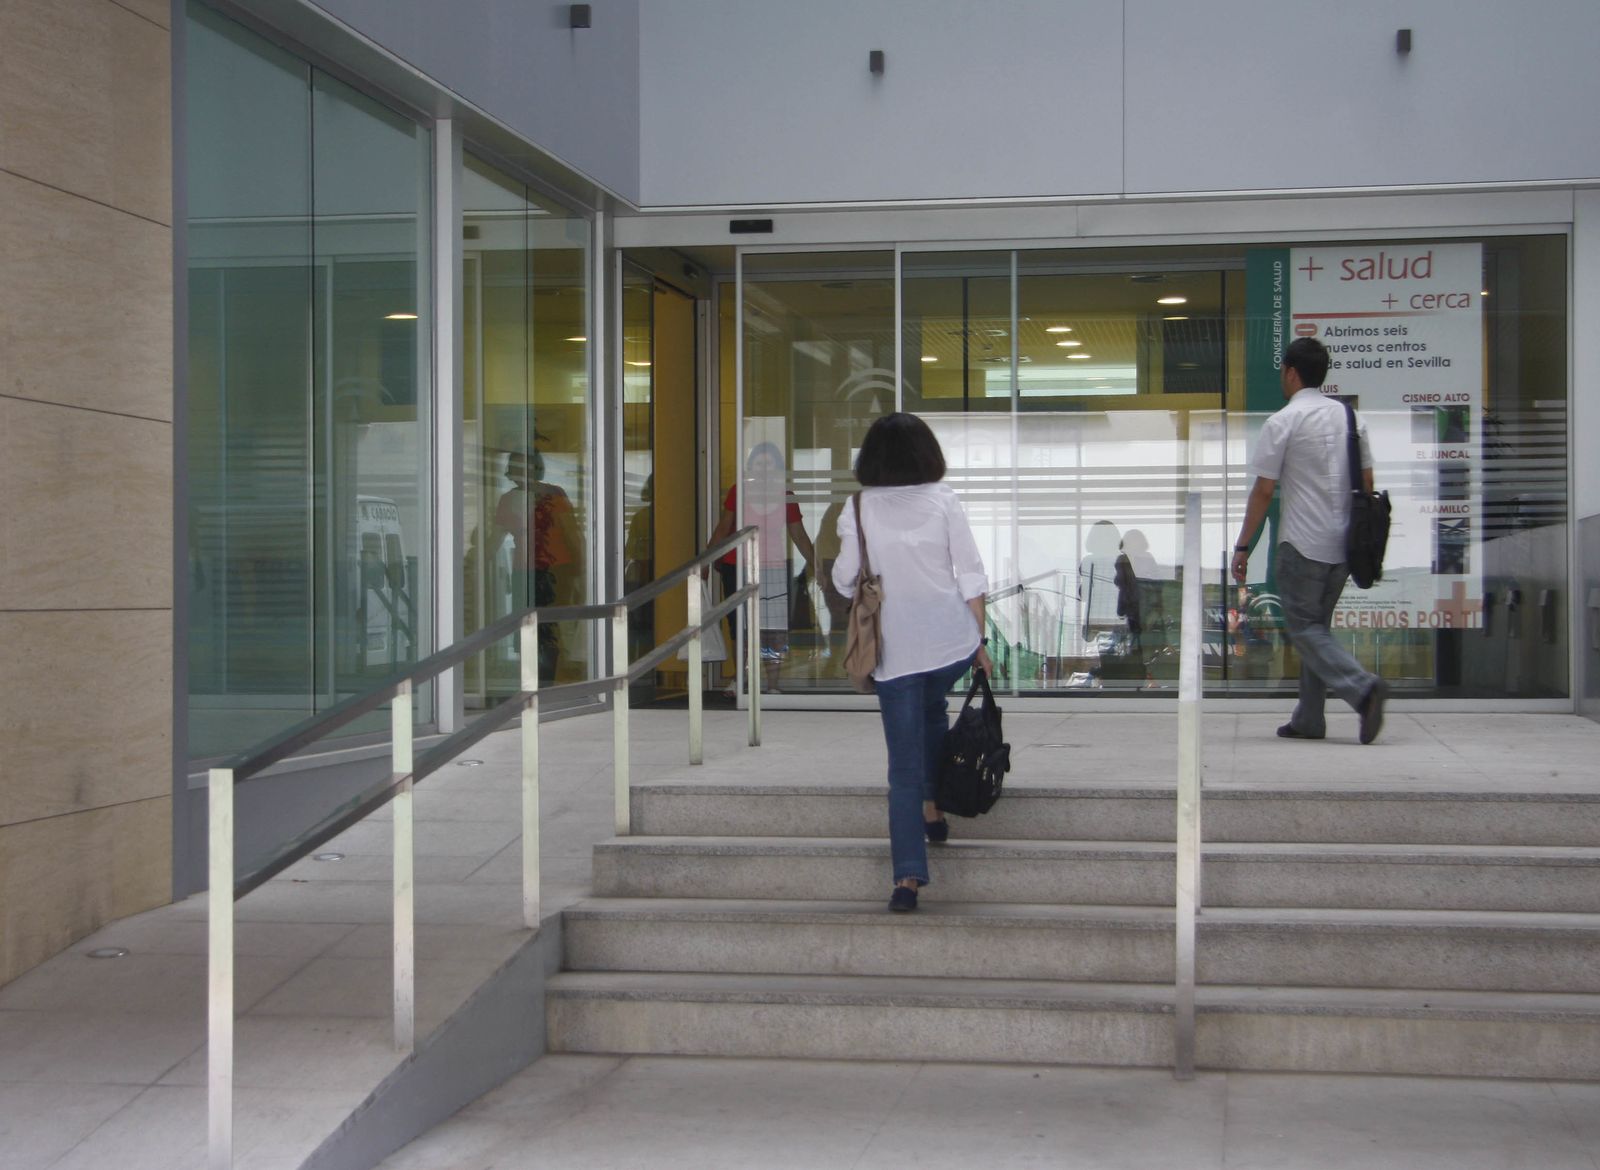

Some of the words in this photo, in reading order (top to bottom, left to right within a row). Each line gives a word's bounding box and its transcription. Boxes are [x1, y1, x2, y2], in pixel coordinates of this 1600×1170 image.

[1340, 251, 1433, 281] salud
[1273, 261, 1282, 293] SALUD
[1273, 295, 1282, 308] DE
[1409, 292, 1471, 310] cerca
[1324, 326, 1379, 337] Abrimos
[1383, 325, 1408, 336] seis
[1272, 310, 1282, 370] CONSEJERÍA
[1376, 341, 1427, 352] centros
[1346, 358, 1382, 369] salud
[1386, 359, 1403, 368] en
[1408, 356, 1451, 368] Sevilla
[1402, 393, 1441, 403] CISNEO
[1444, 393, 1470, 402] ALTO
[1416, 450, 1426, 459] EL
[1430, 450, 1470, 459] JUNCAL
[1419, 504, 1470, 514] ALAMILLO
[1333, 610, 1409, 629] ECEMOS
[1417, 610, 1453, 629] POR
[1461, 610, 1478, 629] TI
